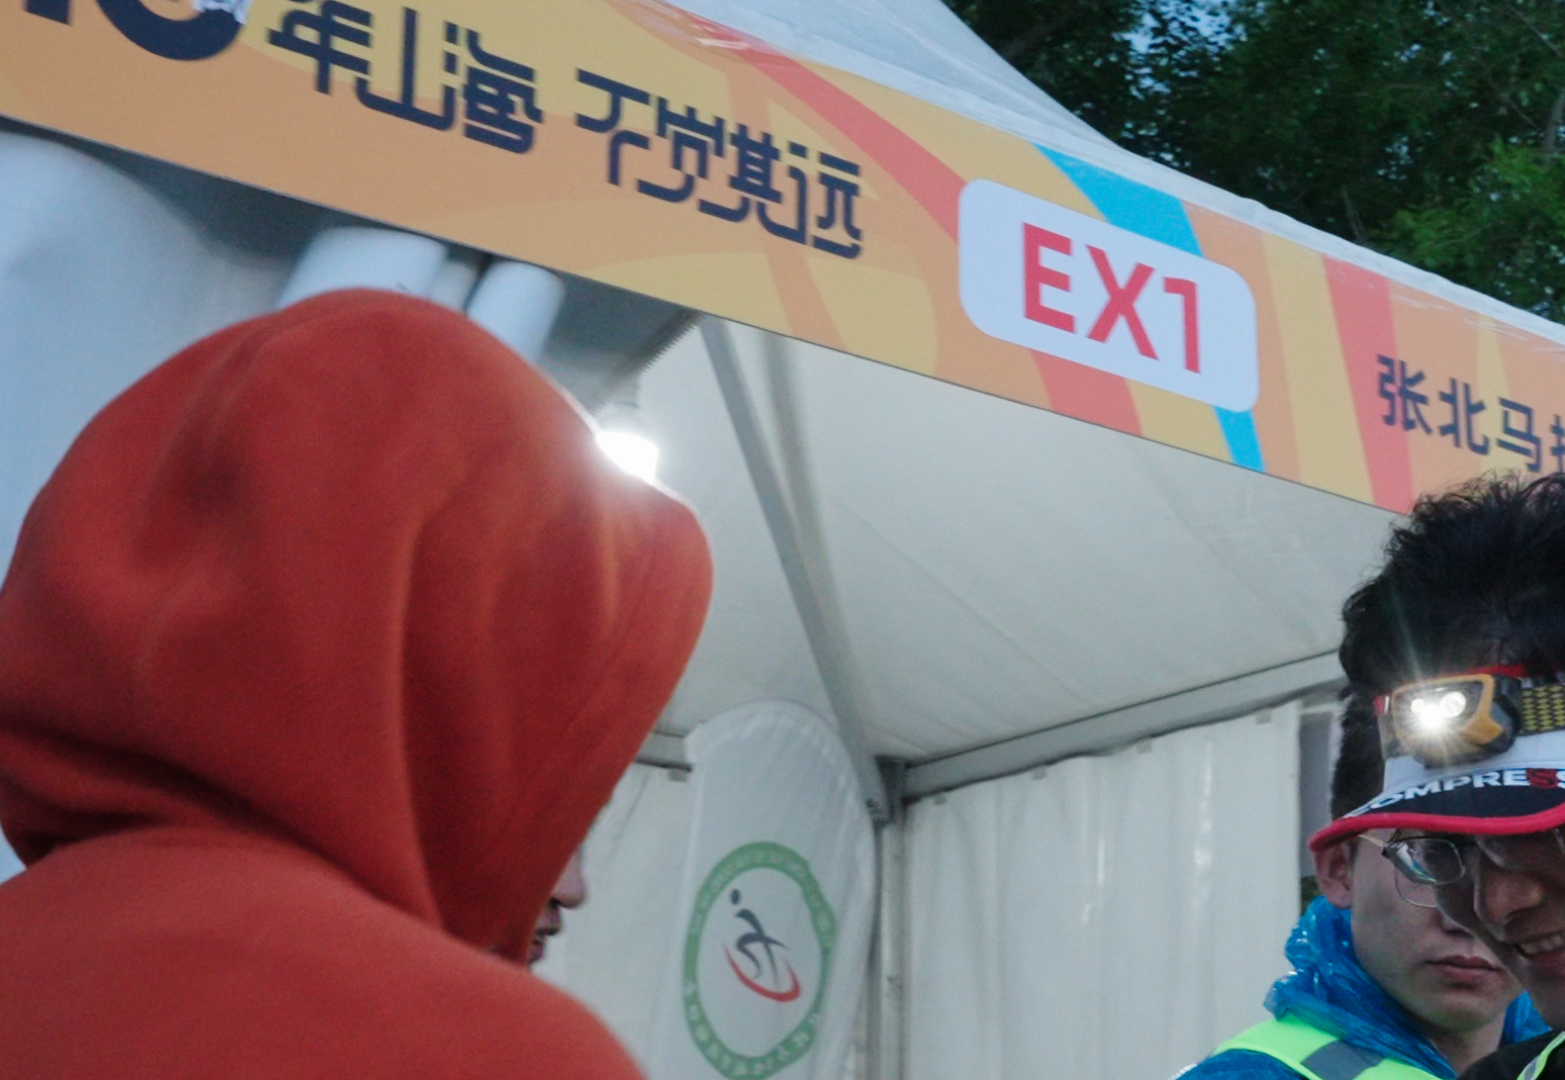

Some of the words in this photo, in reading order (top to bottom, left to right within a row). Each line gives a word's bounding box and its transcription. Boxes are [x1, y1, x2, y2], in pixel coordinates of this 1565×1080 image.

[575, 67, 863, 259] 不觉其远
[1022, 221, 1201, 375] EX1
